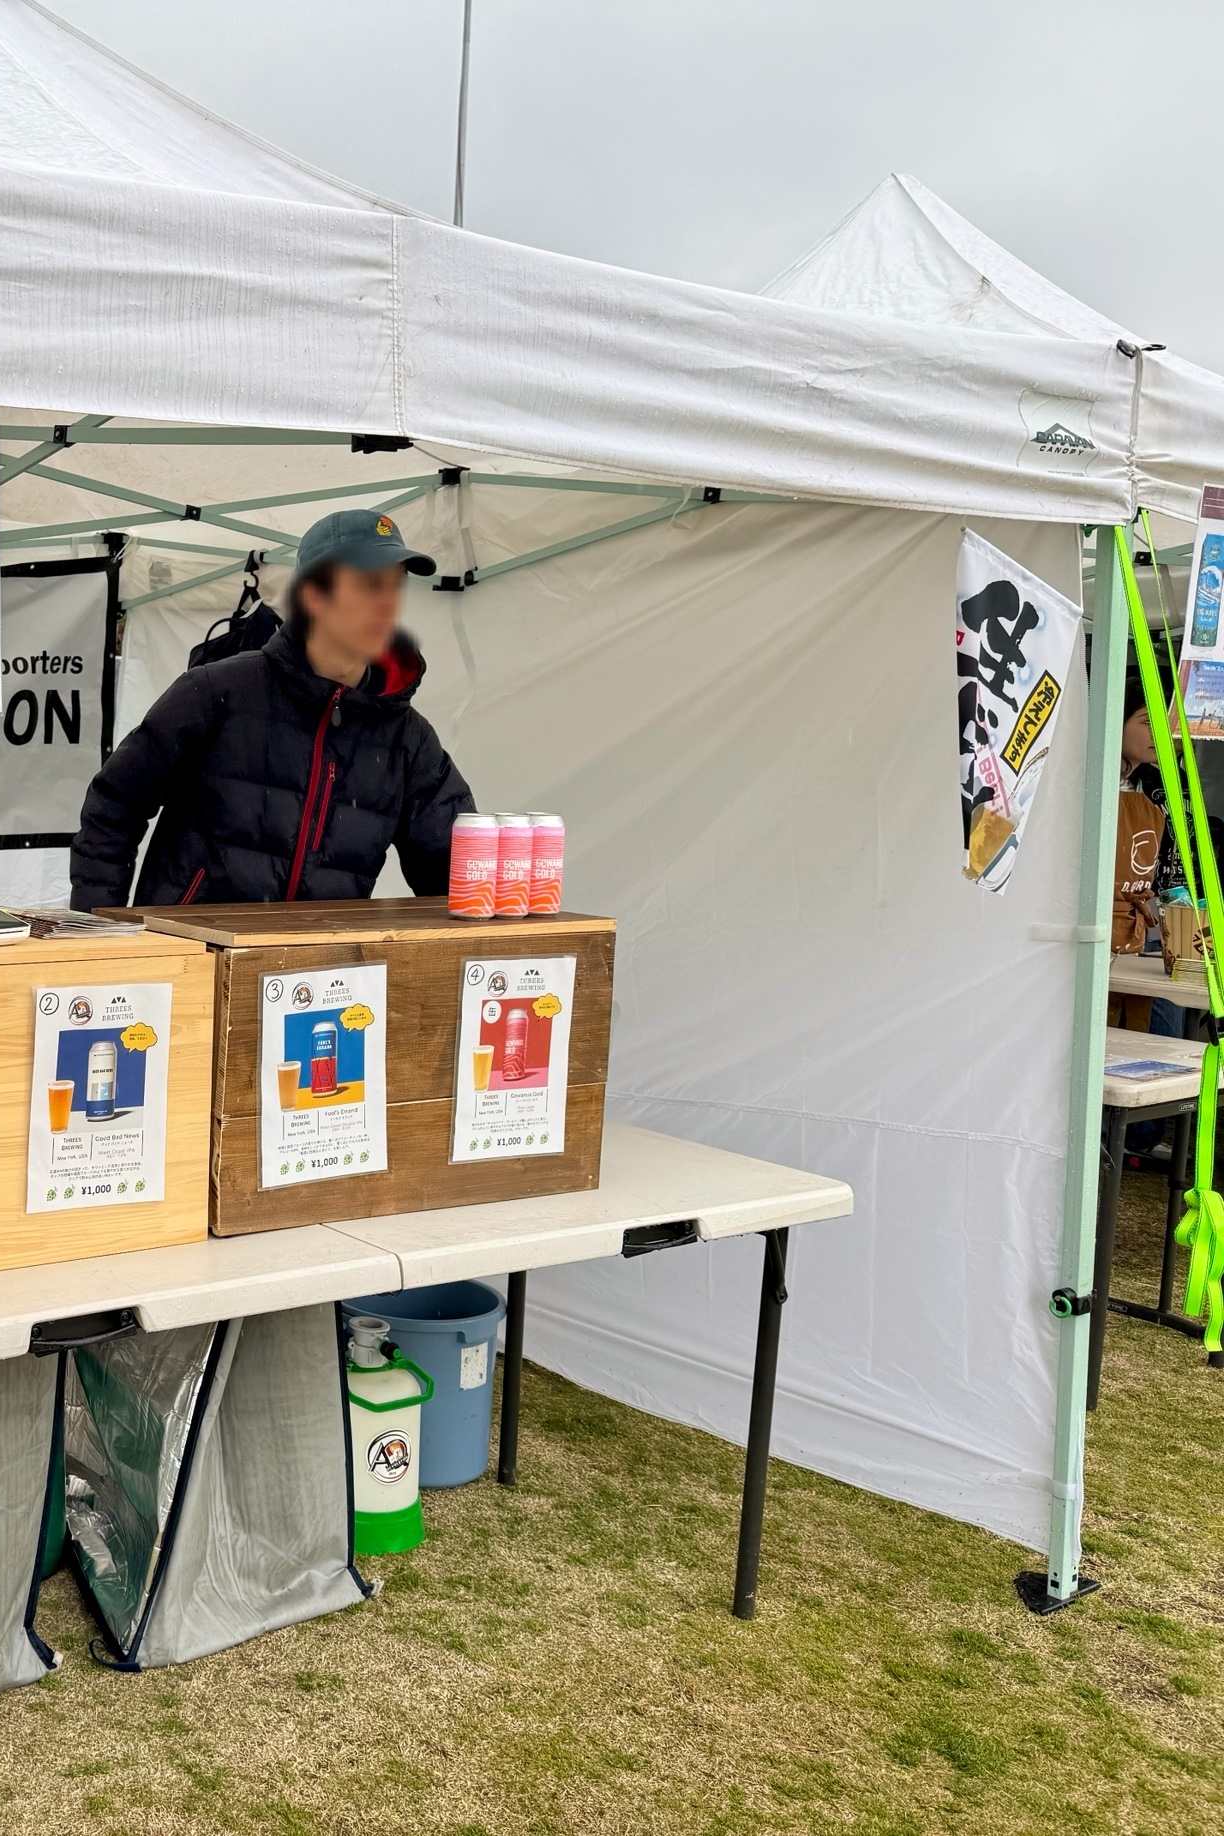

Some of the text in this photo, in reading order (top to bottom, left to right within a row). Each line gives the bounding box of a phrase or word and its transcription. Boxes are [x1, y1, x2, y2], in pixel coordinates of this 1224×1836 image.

[1040, 445, 1085, 455] CANOPY
[497, 1137, 521, 1147] ¥1,000
[311, 1157, 338, 1168] ¥1,000
[81, 1184, 112, 1196] ¥1,000
